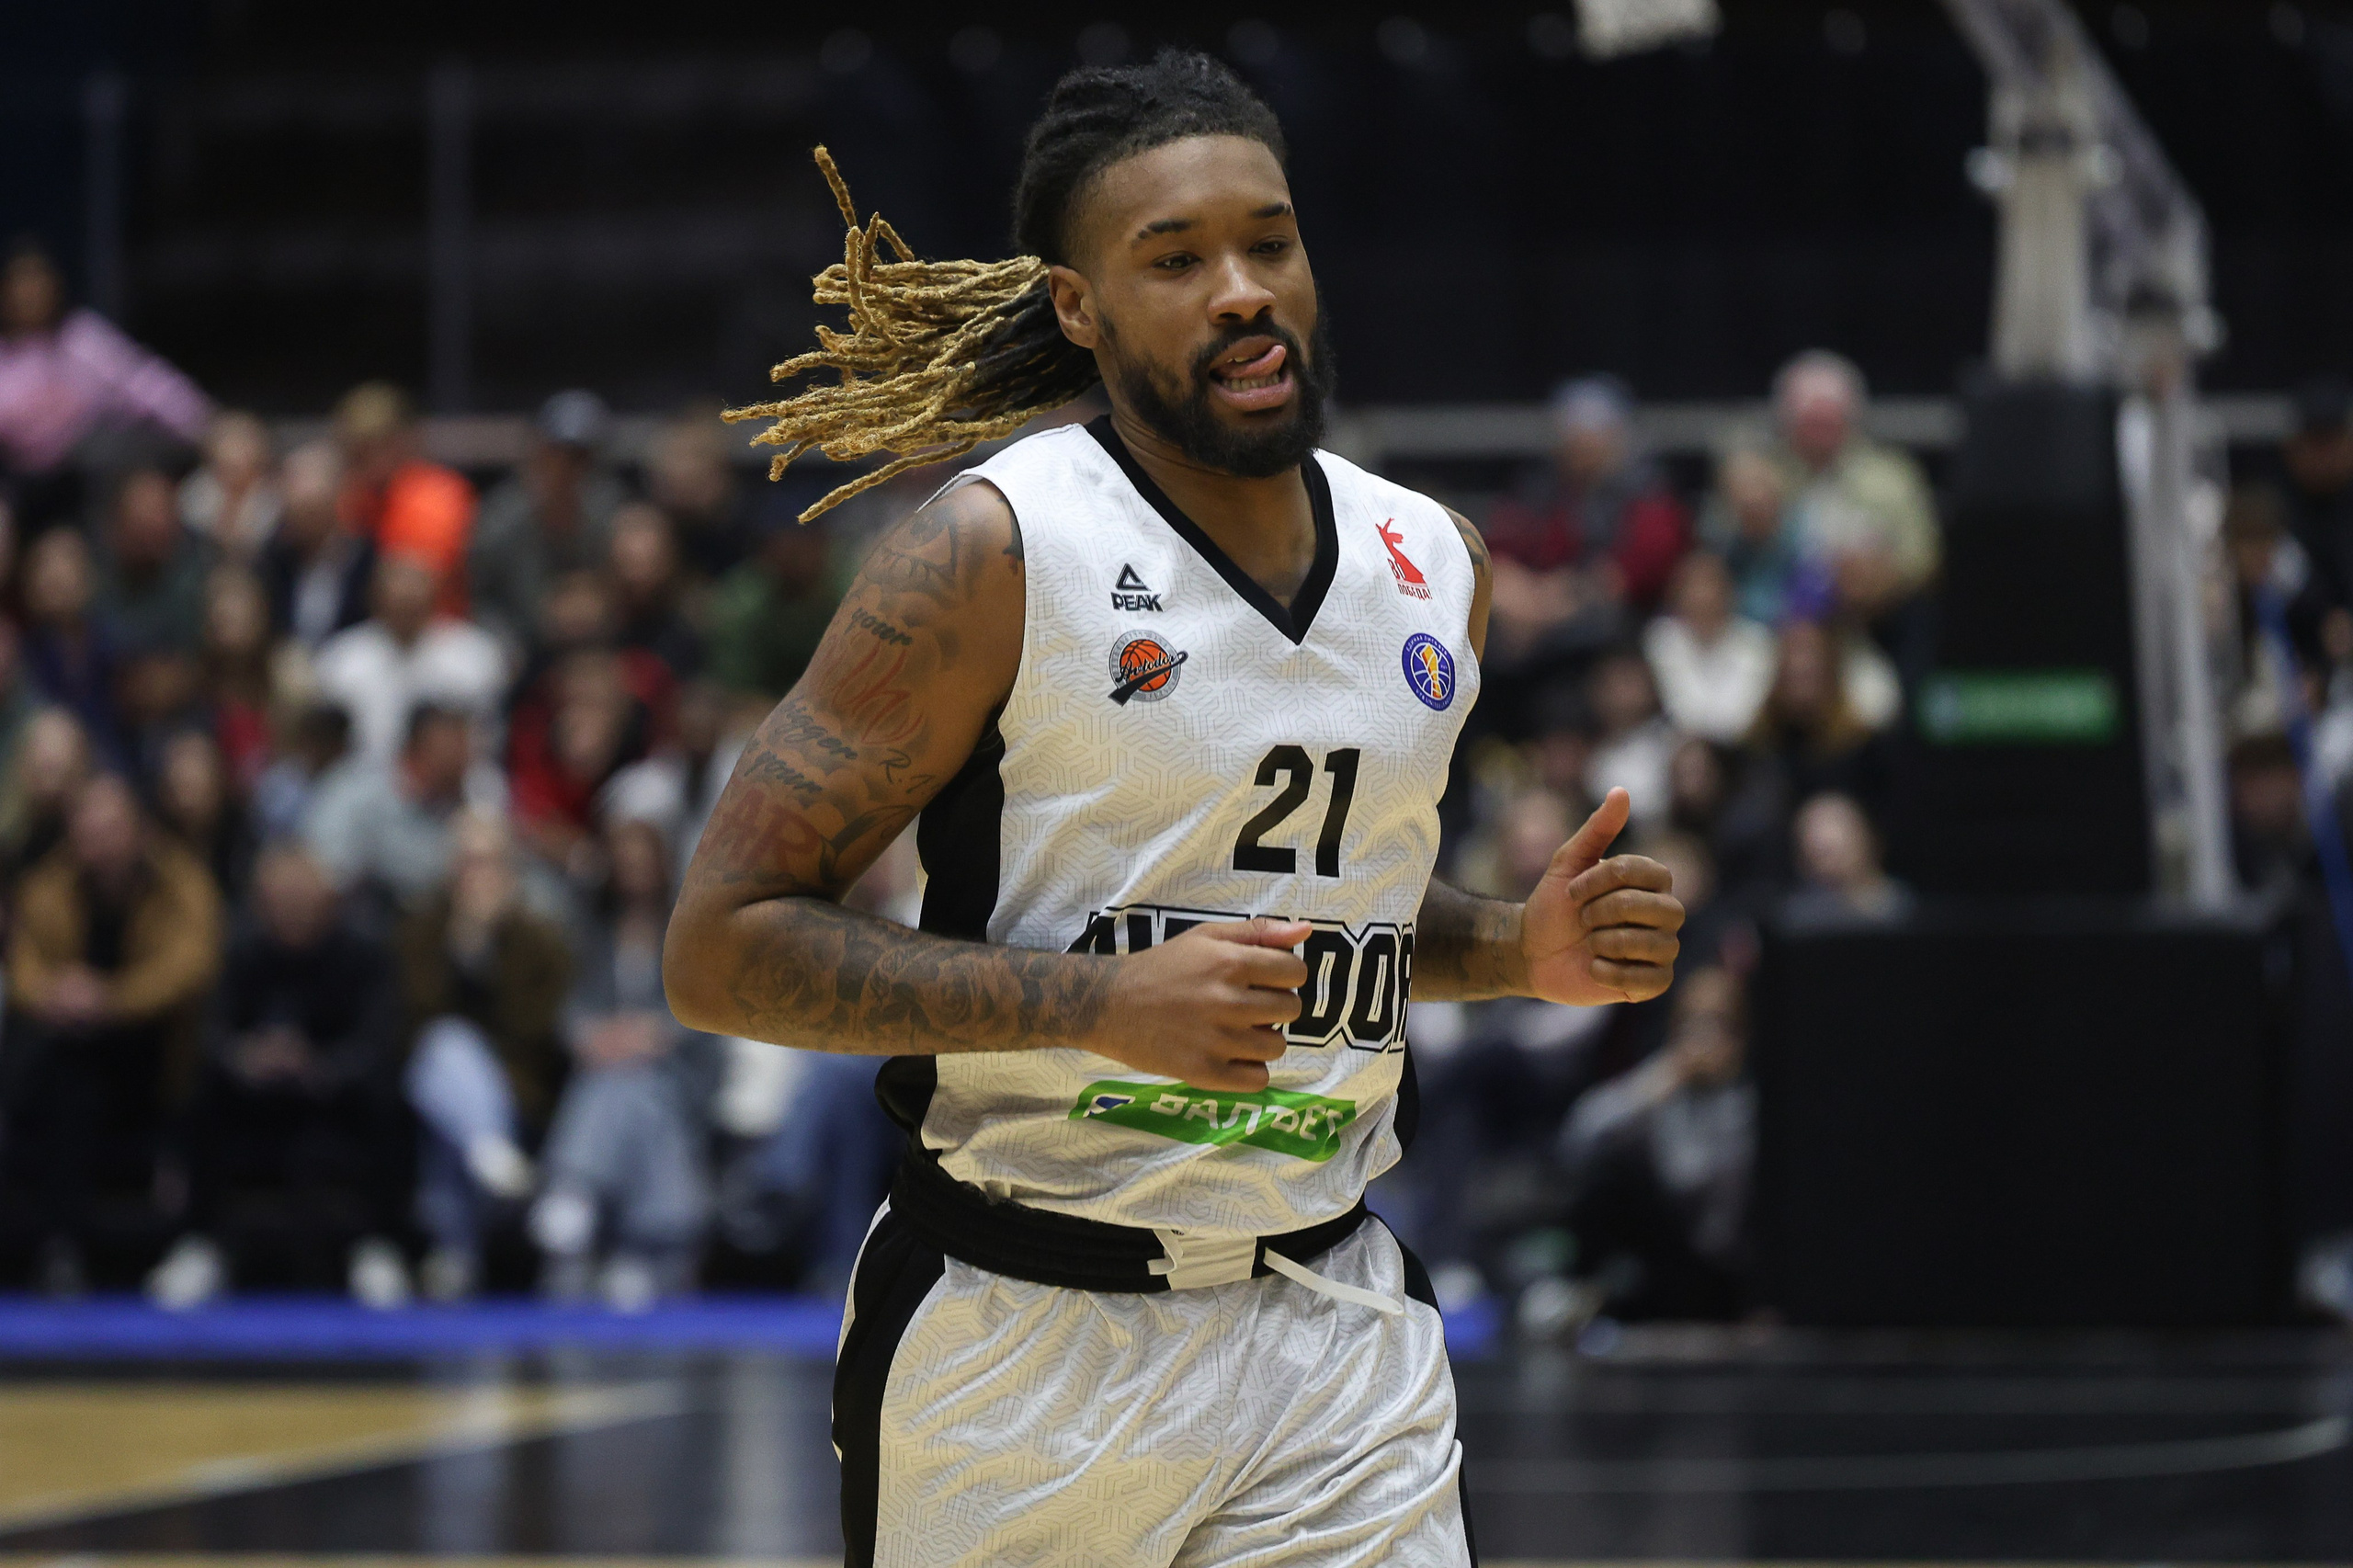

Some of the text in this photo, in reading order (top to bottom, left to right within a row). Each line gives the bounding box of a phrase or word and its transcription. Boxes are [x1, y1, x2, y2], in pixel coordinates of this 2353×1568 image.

[1110, 591, 1164, 612] PEAK
[1397, 583, 1433, 601] ПОБЕДА!
[1233, 744, 1360, 878] 21
